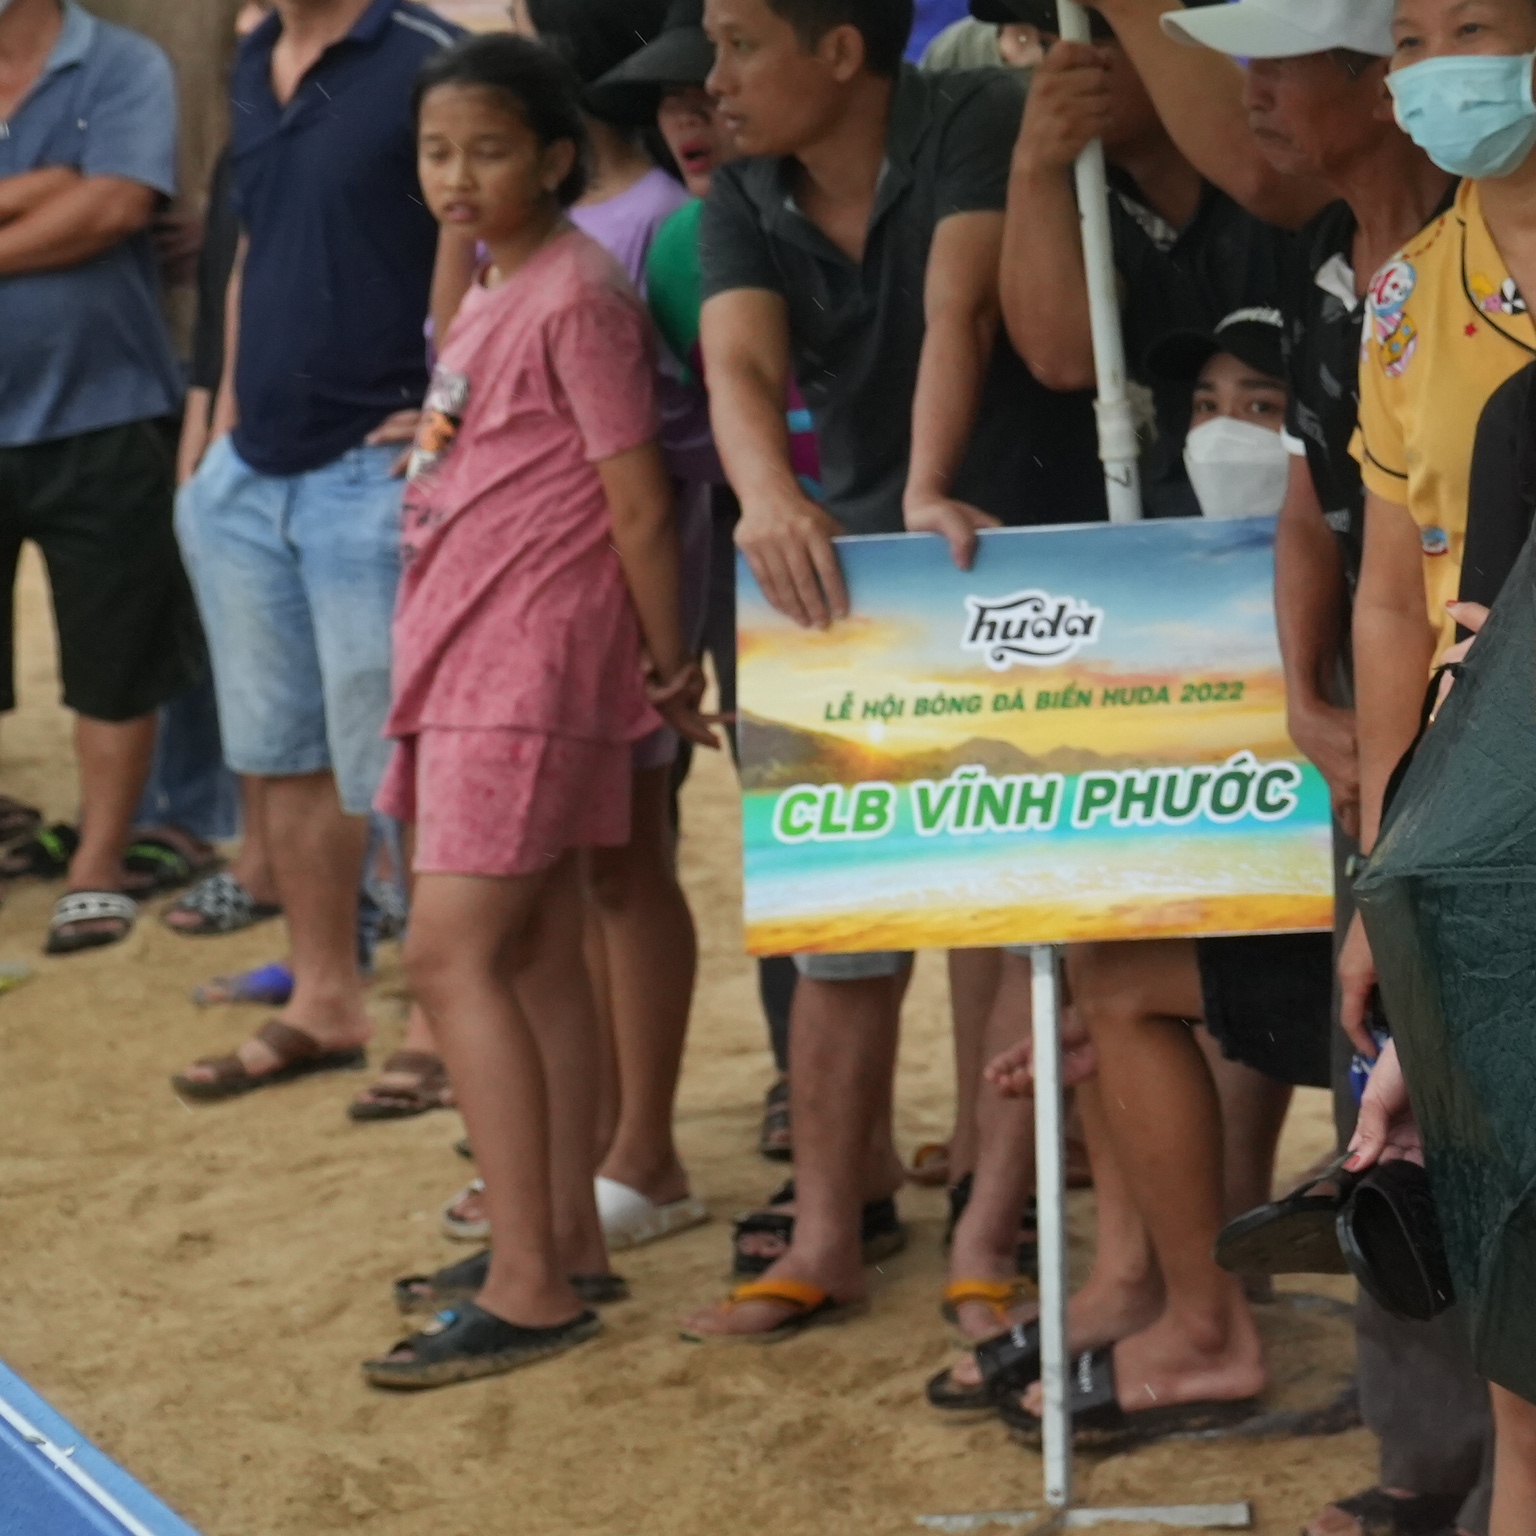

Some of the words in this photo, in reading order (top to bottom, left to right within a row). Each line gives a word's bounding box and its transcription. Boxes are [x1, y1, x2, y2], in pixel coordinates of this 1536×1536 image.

[969, 595, 1095, 662] huda
[862, 693, 904, 724] HỘI
[913, 687, 982, 715] BÓNG
[992, 687, 1025, 712] ĐÁ
[1101, 685, 1170, 707] HUDA
[1181, 680, 1245, 704] 2022
[780, 789, 891, 835] CLB
[914, 771, 1059, 829] VĨNH
[1077, 758, 1297, 822] PHƯỚC
